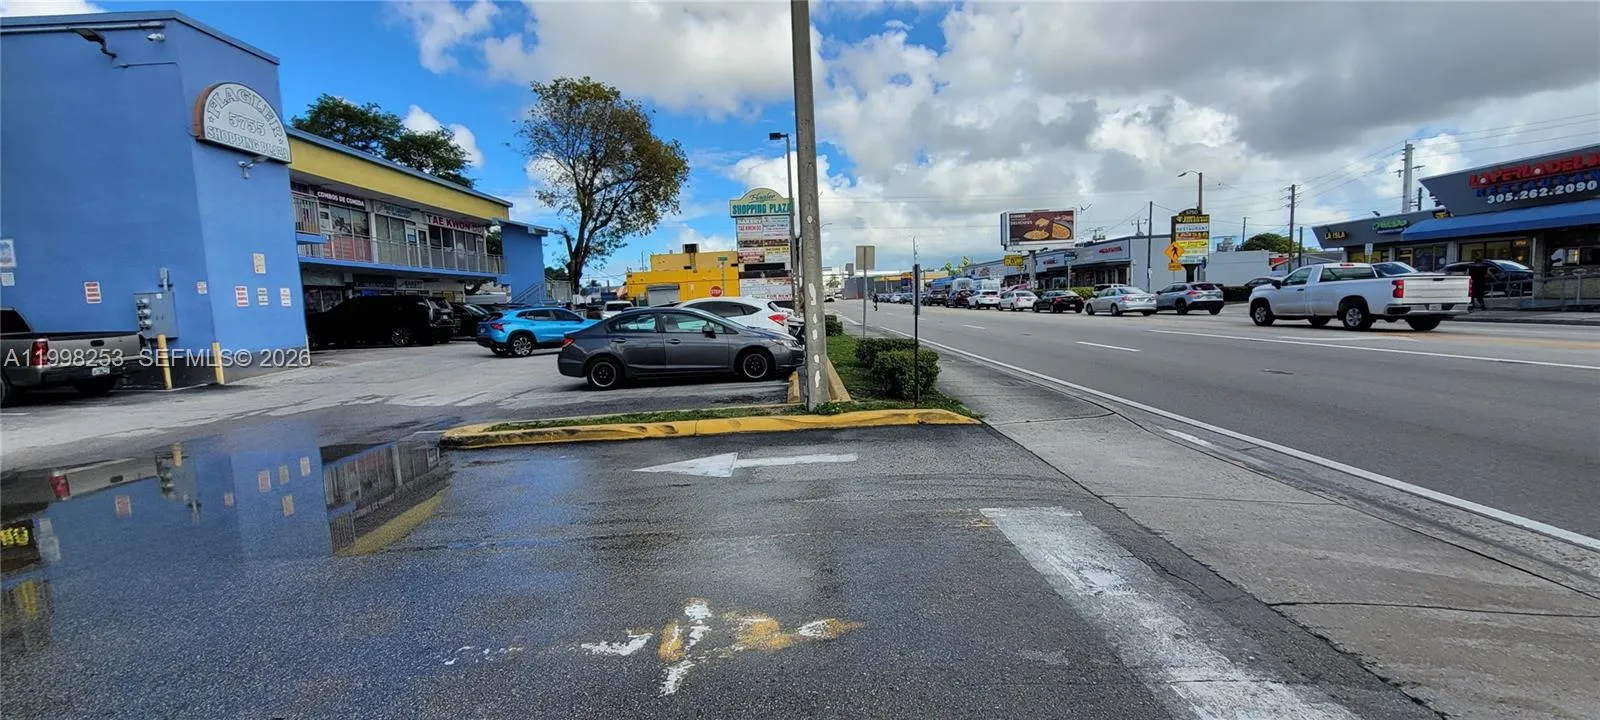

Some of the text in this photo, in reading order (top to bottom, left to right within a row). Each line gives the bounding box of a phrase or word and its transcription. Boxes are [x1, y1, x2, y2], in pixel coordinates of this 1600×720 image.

[207, 87, 283, 138] FLAGLER
[228, 112, 266, 137] 5755
[207, 126, 289, 160] SHOPPING PLAZA
[317, 191, 338, 201] COMBOS
[346, 197, 365, 207] COMIDA
[749, 191, 776, 202] Flagler
[1487, 180, 1598, 204] 305.262.2090
[732, 204, 767, 214] SHOPPING
[426, 214, 445, 226] TAE
[446, 219, 470, 230] KWON
[1324, 231, 1346, 240] LA ISLA
